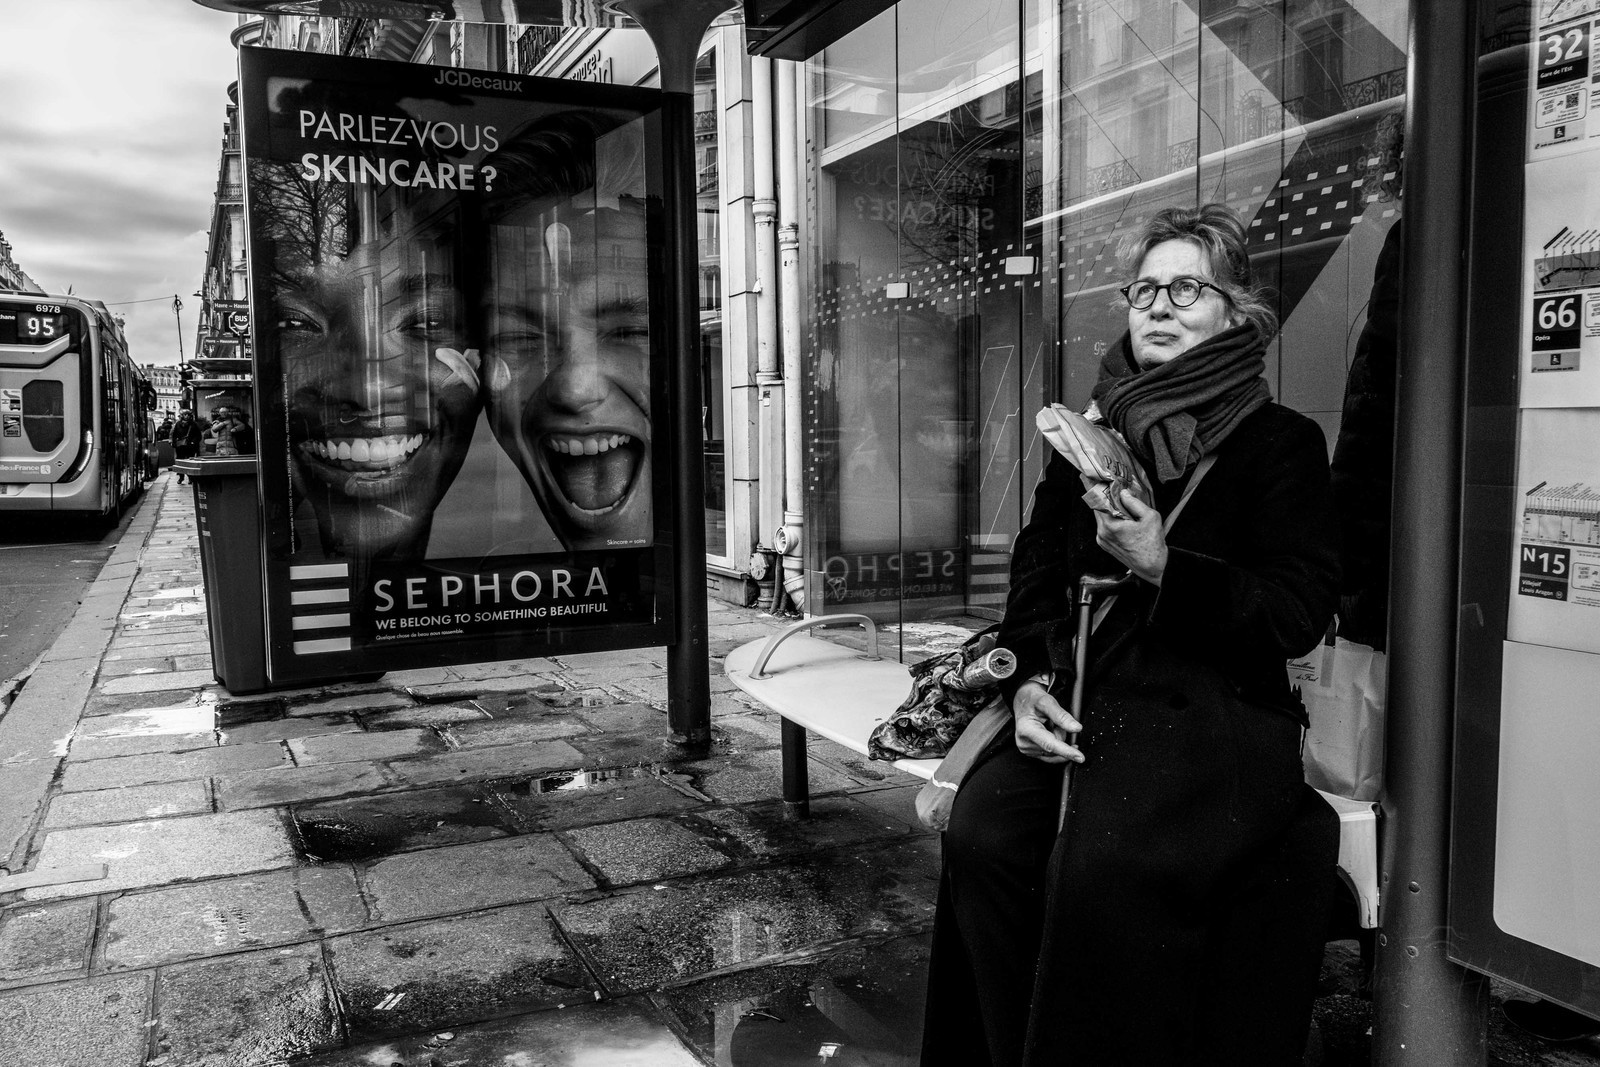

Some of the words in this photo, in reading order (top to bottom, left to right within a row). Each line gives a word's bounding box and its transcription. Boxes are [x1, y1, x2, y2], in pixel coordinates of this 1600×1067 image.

[1543, 28, 1583, 66] 32
[434, 67, 523, 94] JCDecaux
[1540, 71, 1552, 79] Gare
[299, 109, 498, 153] PARLEZ-VOUS
[35, 304, 61, 314] 6978
[234, 314, 248, 322] BUS
[1538, 297, 1576, 330] 66
[27, 317, 55, 336] 95
[1523, 547, 1566, 575] N15
[373, 566, 609, 612] SEPHORA
[1535, 588, 1554, 597] Aragon
[375, 618, 397, 630] WE
[400, 614, 452, 628] BELONG
[454, 612, 471, 624] TO
[474, 606, 547, 623] SOMETHING
[549, 602, 609, 617] BEAUTIFUL
